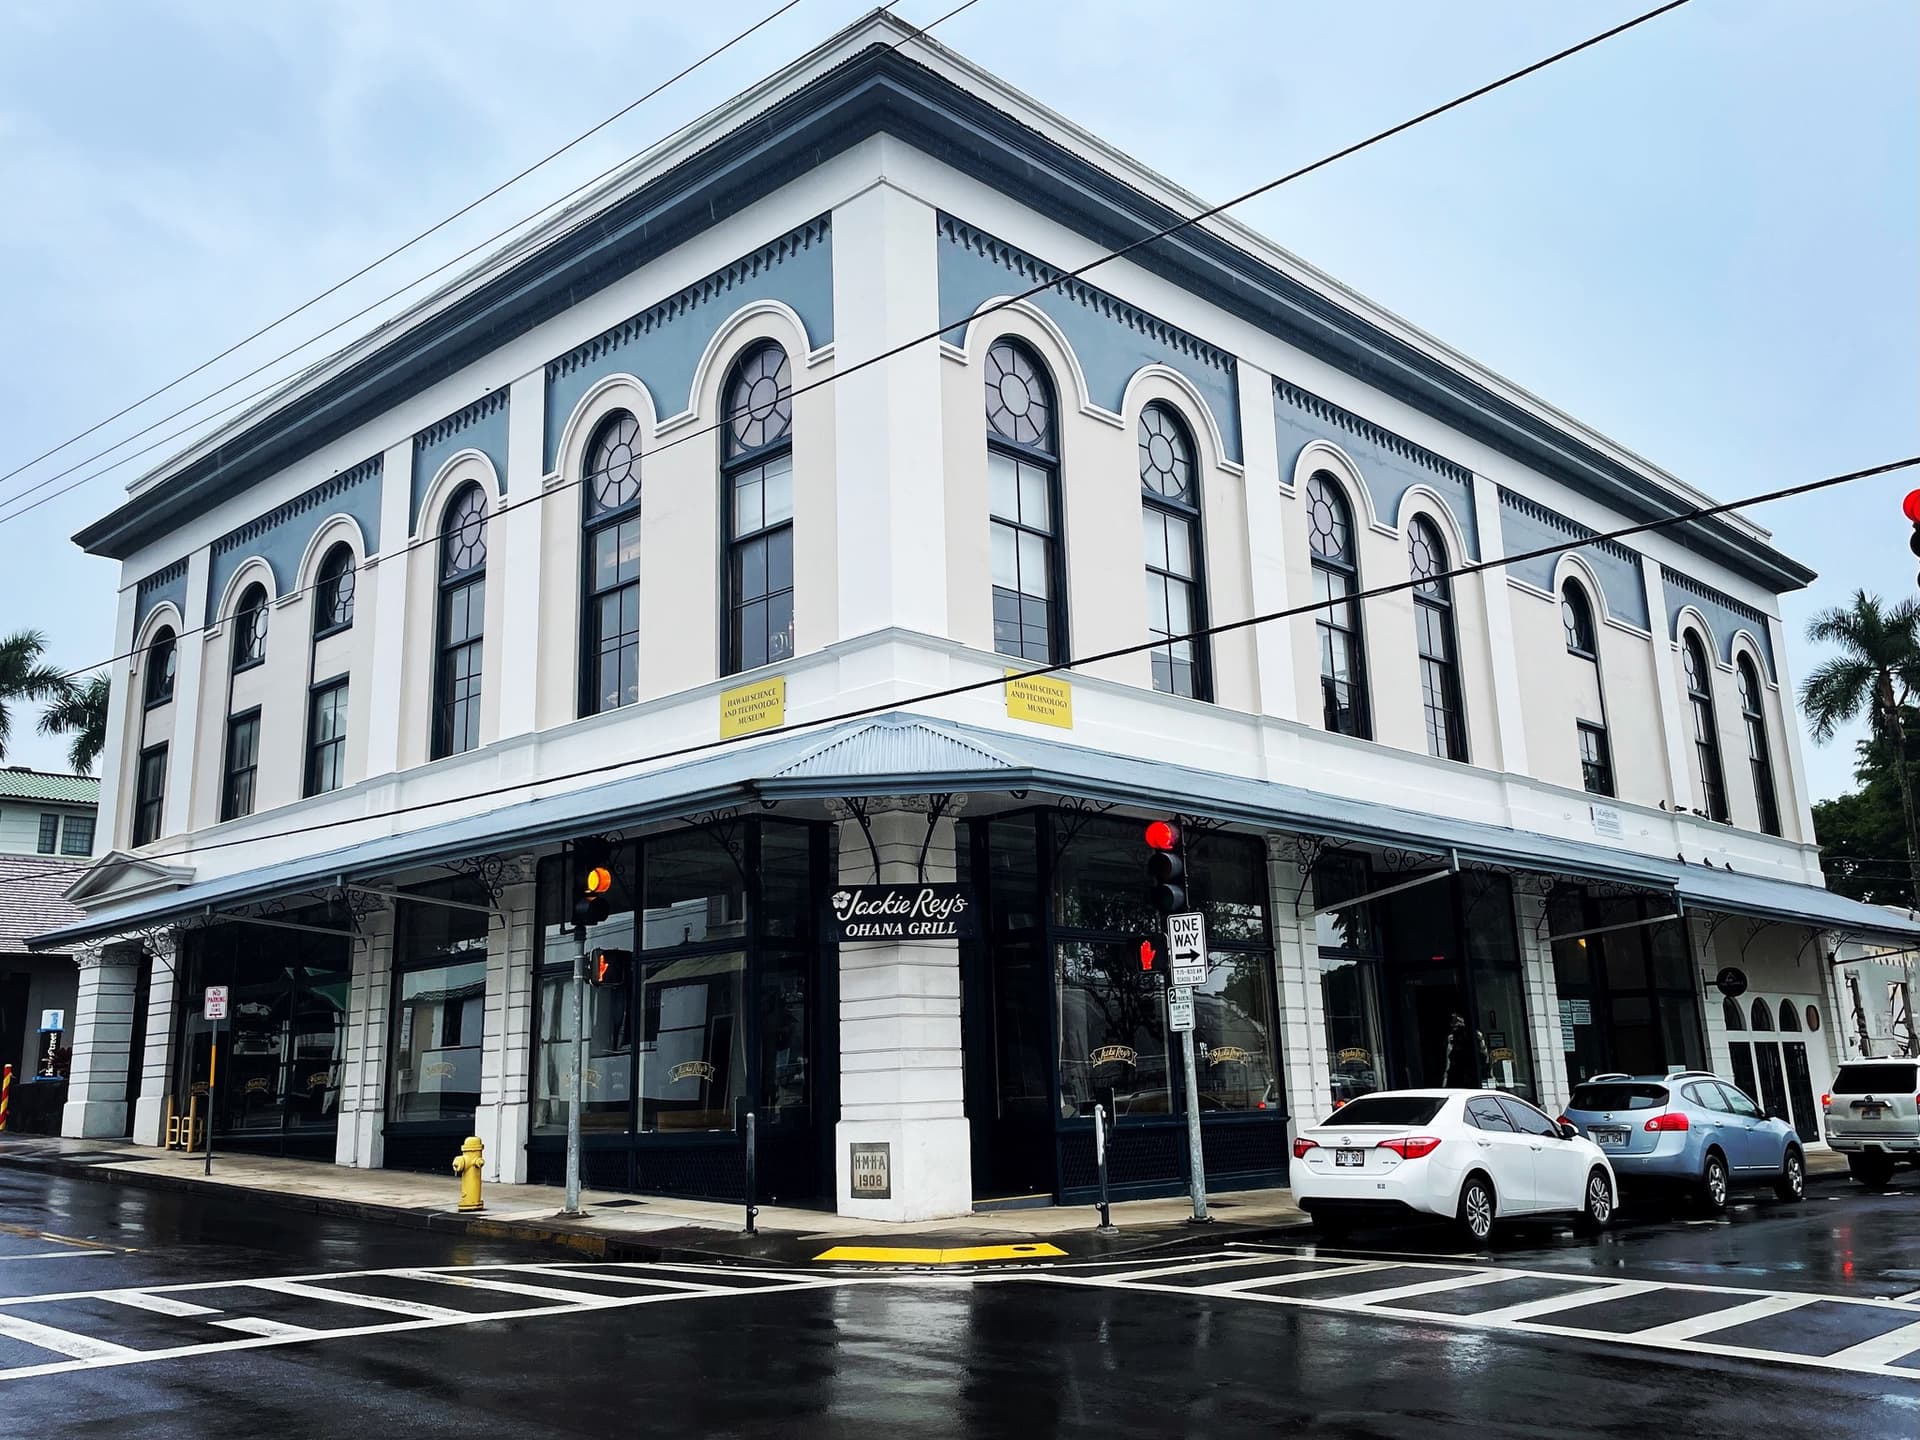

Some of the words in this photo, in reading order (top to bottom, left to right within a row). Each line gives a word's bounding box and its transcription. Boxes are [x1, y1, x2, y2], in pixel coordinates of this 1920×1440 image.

[750, 688, 776, 701] SCIENCE
[1014, 681, 1038, 692] HAWAII
[1039, 685, 1064, 698] SCIENCE
[1011, 690, 1025, 698] AND
[1026, 693, 1067, 708] TECHNOLOGY
[724, 709, 737, 718] AND
[738, 698, 779, 715] TECHNOLOGY
[1027, 704, 1055, 716] MUSEUM
[738, 711, 766, 724] MUSEUM
[836, 890, 911, 921] Jackie
[910, 888, 969, 919] Rey's
[845, 923, 903, 937] OHANA
[908, 921, 958, 935] GRILL
[1172, 918, 1199, 932] ONE
[1174, 932, 1199, 947] WAY
[1169, 989, 1175, 1002] 2
[859, 1174, 882, 1187] 1908
